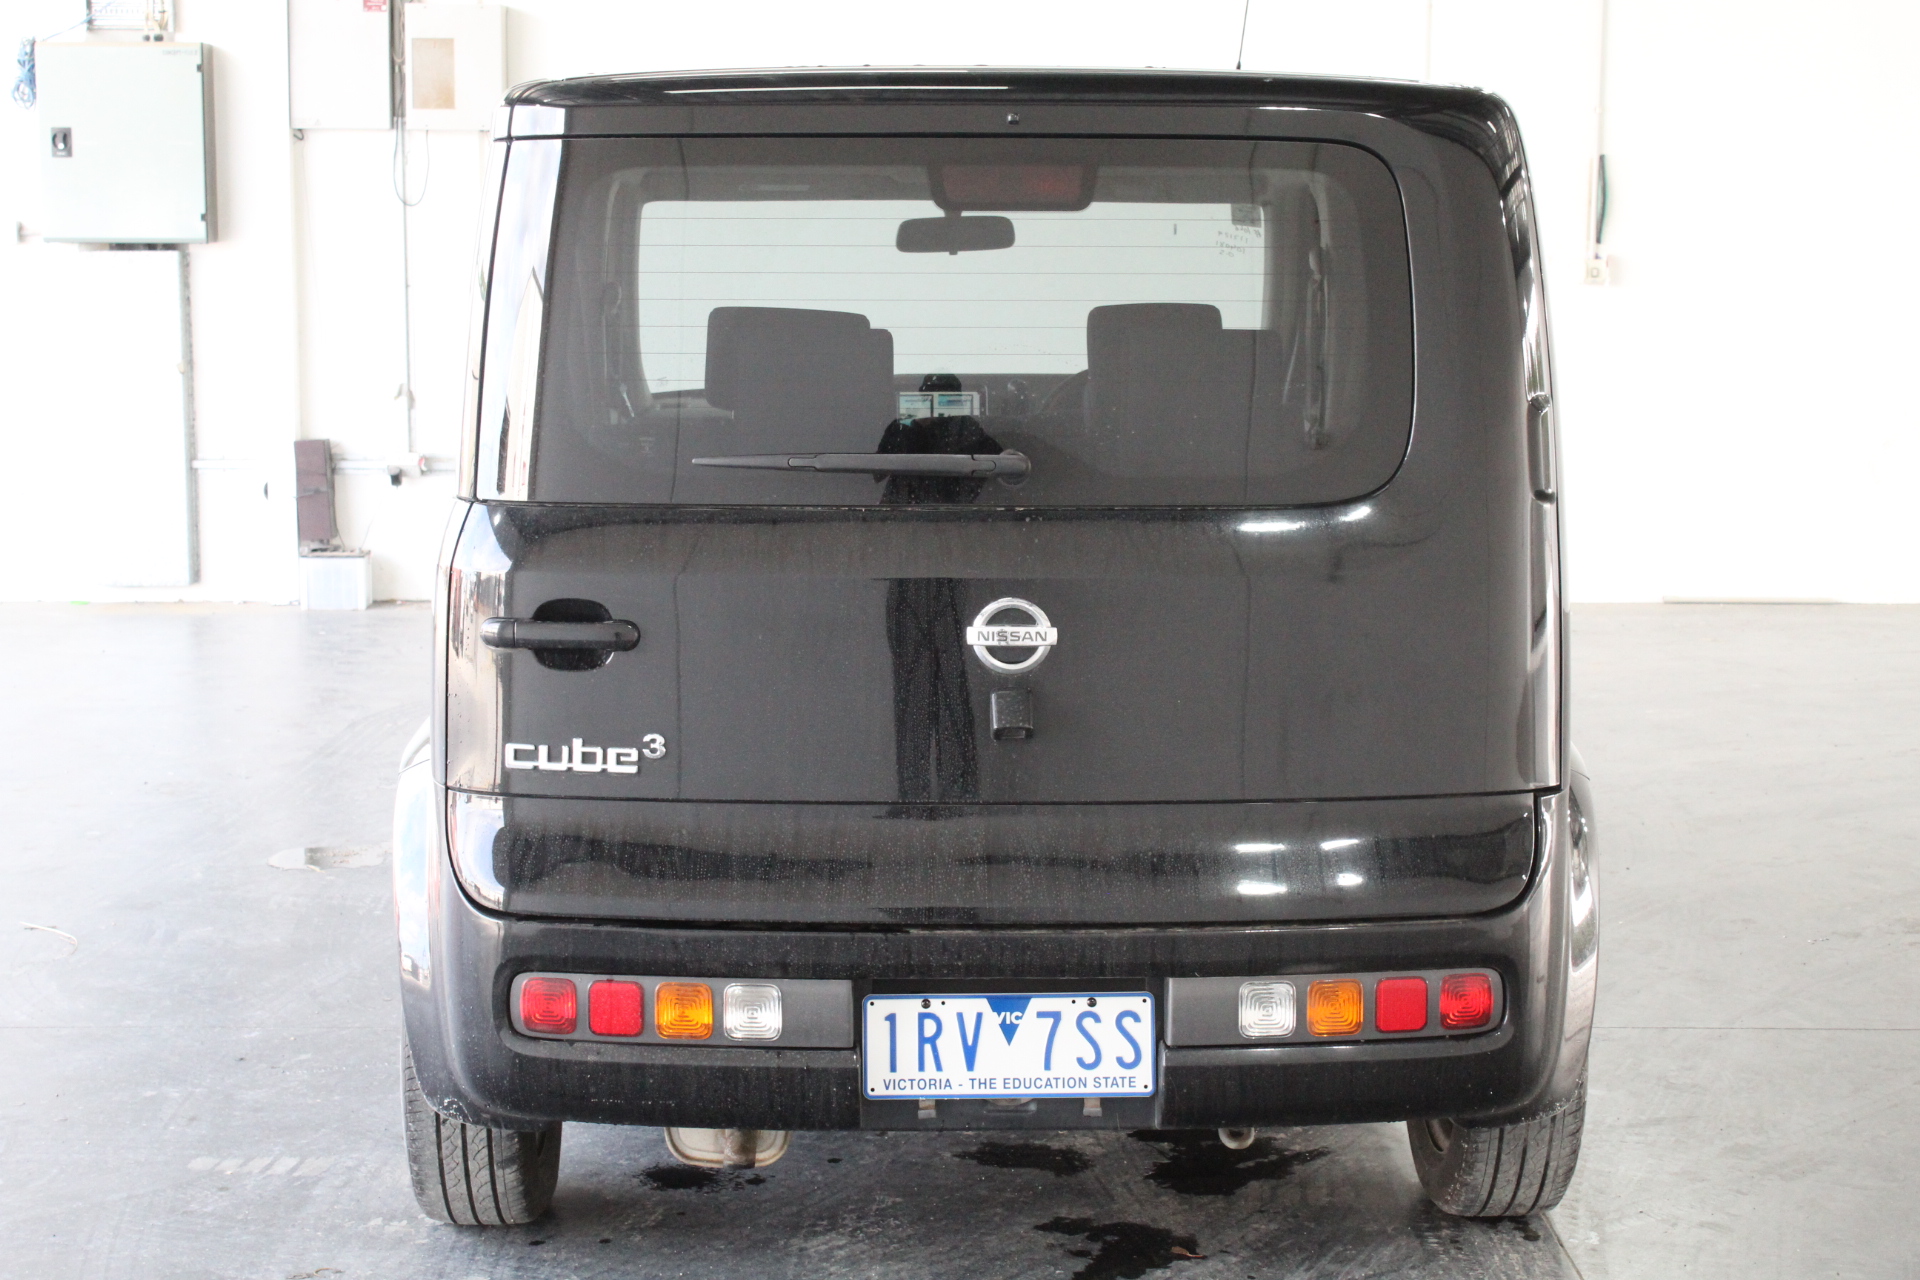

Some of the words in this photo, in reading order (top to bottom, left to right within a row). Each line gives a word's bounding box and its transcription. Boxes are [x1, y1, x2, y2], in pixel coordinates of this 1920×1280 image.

[977, 630, 1048, 642] NISSAN
[993, 1011, 1024, 1025] VIC
[883, 1078, 953, 1091] VICTORIA
[968, 1078, 997, 1090] THE
[1002, 1077, 1088, 1090] EDUCATION
[1093, 1076, 1137, 1089] STATE
